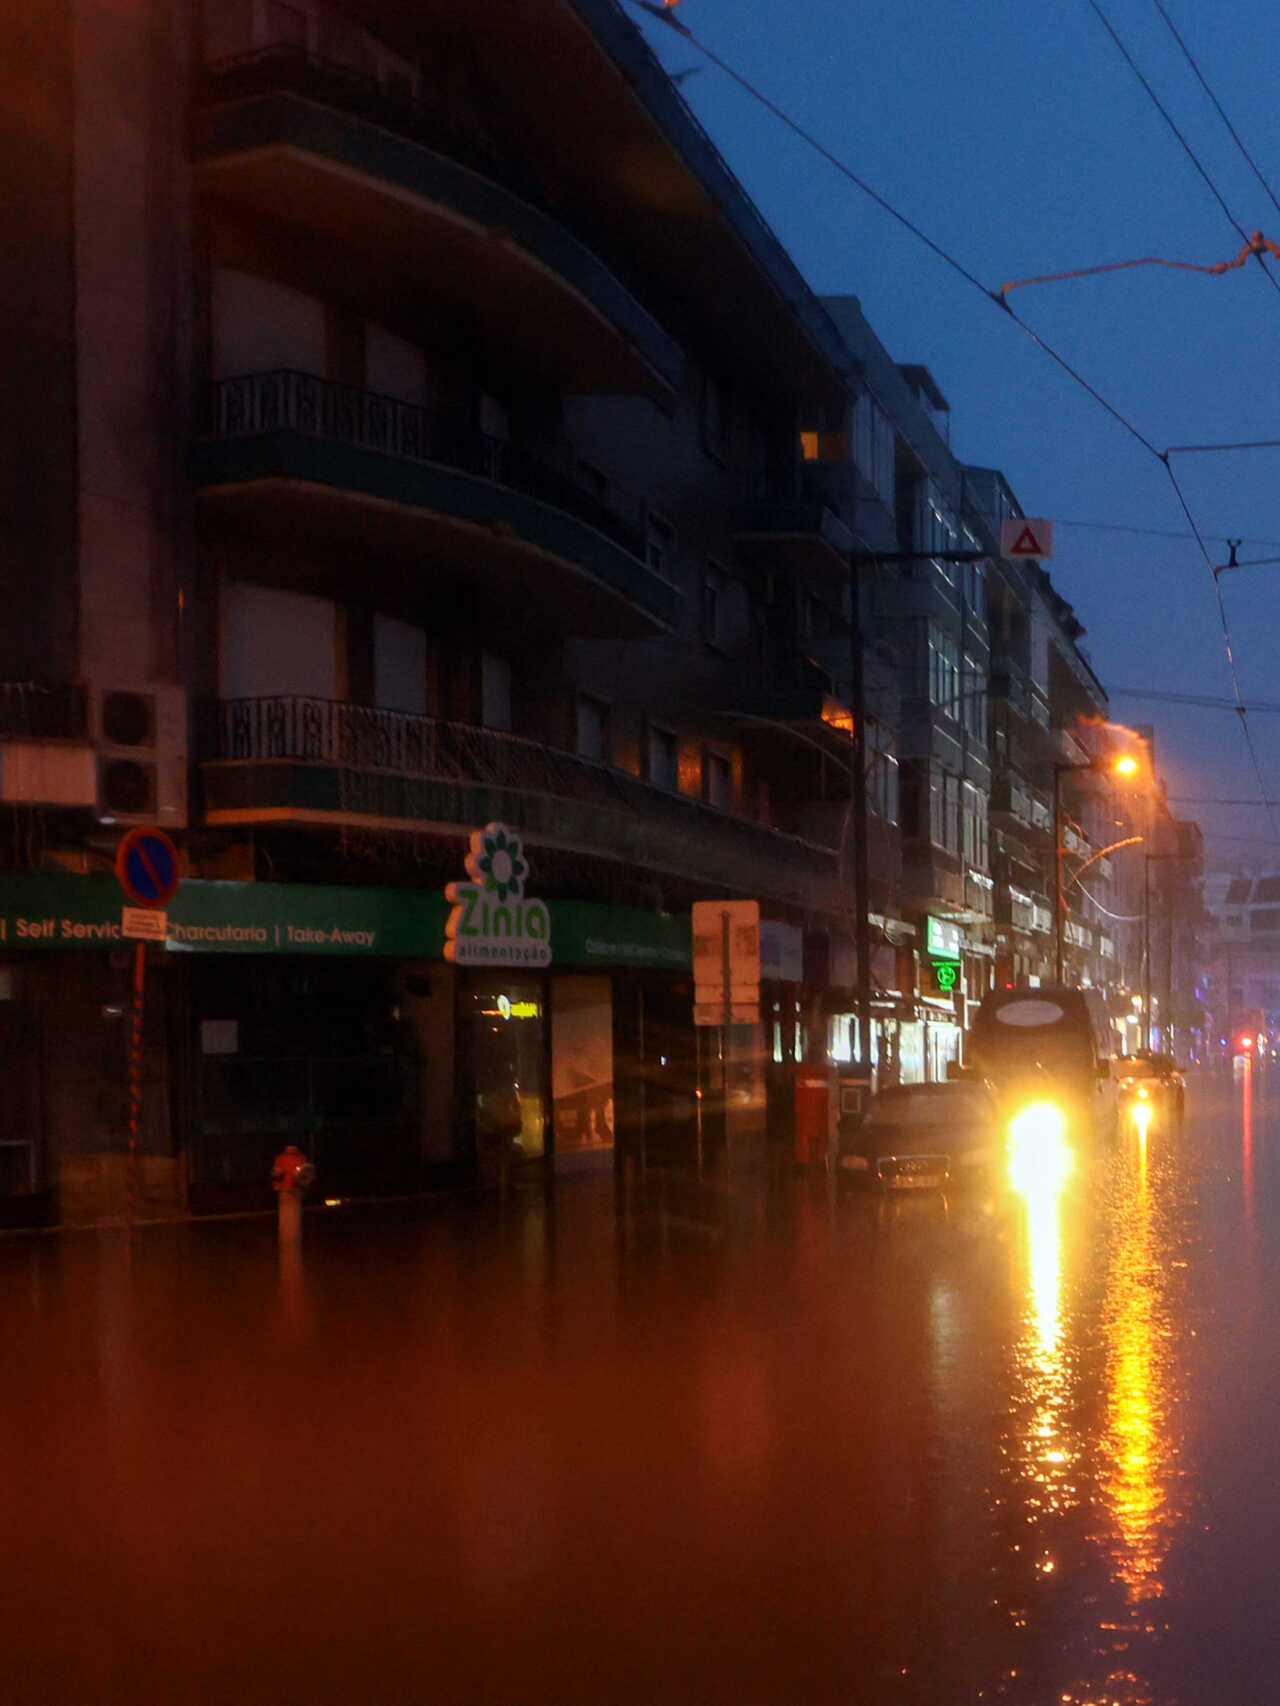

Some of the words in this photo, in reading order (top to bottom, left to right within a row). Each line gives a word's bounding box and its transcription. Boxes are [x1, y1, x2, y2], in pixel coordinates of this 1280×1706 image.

[460, 889, 547, 938] Zinia
[15, 917, 55, 939] Self
[60, 917, 121, 940] Servic
[286, 924, 376, 947] Take-Away
